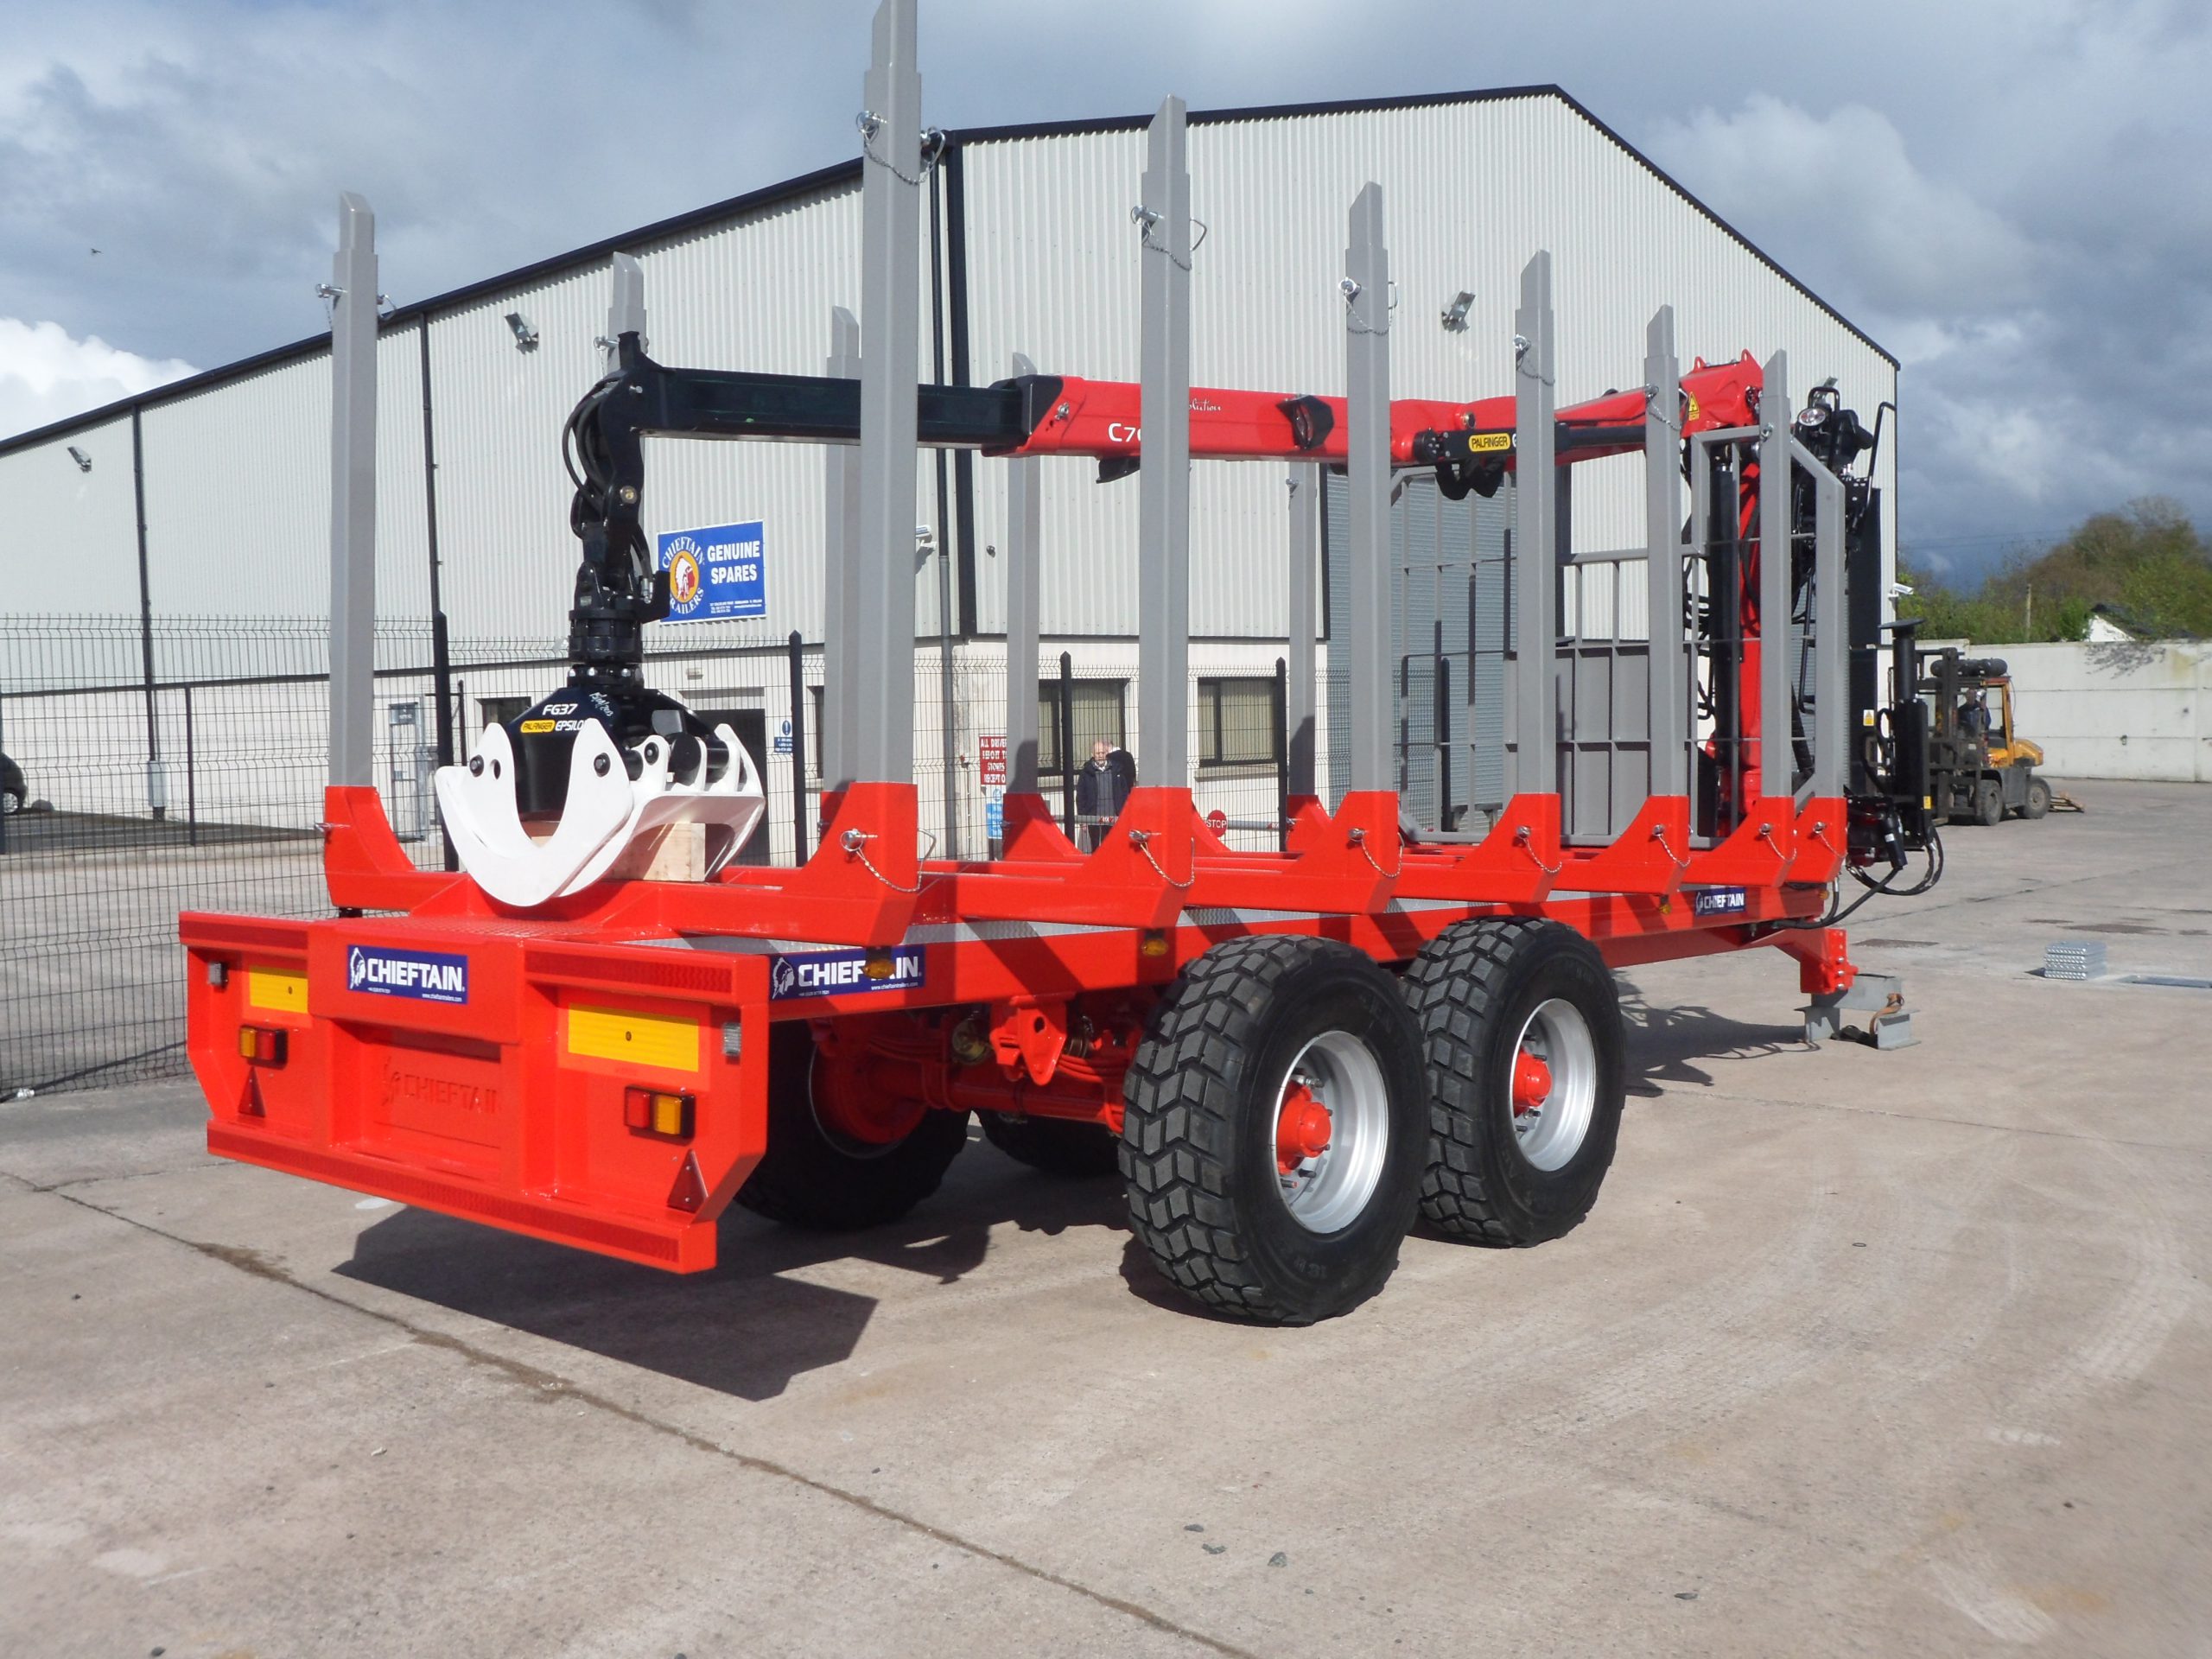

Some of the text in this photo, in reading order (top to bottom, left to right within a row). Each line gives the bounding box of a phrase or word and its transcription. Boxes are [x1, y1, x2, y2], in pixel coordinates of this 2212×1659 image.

[1471, 435, 1509, 449] PALFINGER
[662, 536, 705, 569] CHIEFTAIN
[707, 540, 760, 563] GENUINE
[710, 563, 758, 585] SPARES
[670, 587, 704, 615] RAILERS
[542, 703, 579, 715] FG37
[555, 720, 586, 732] EPSILO
[1206, 819, 1227, 829] STOP
[1704, 893, 1745, 909] CHIEFTAIN
[367, 957, 463, 992] CHIEFTAIN
[798, 956, 919, 987] CHIEFIN
